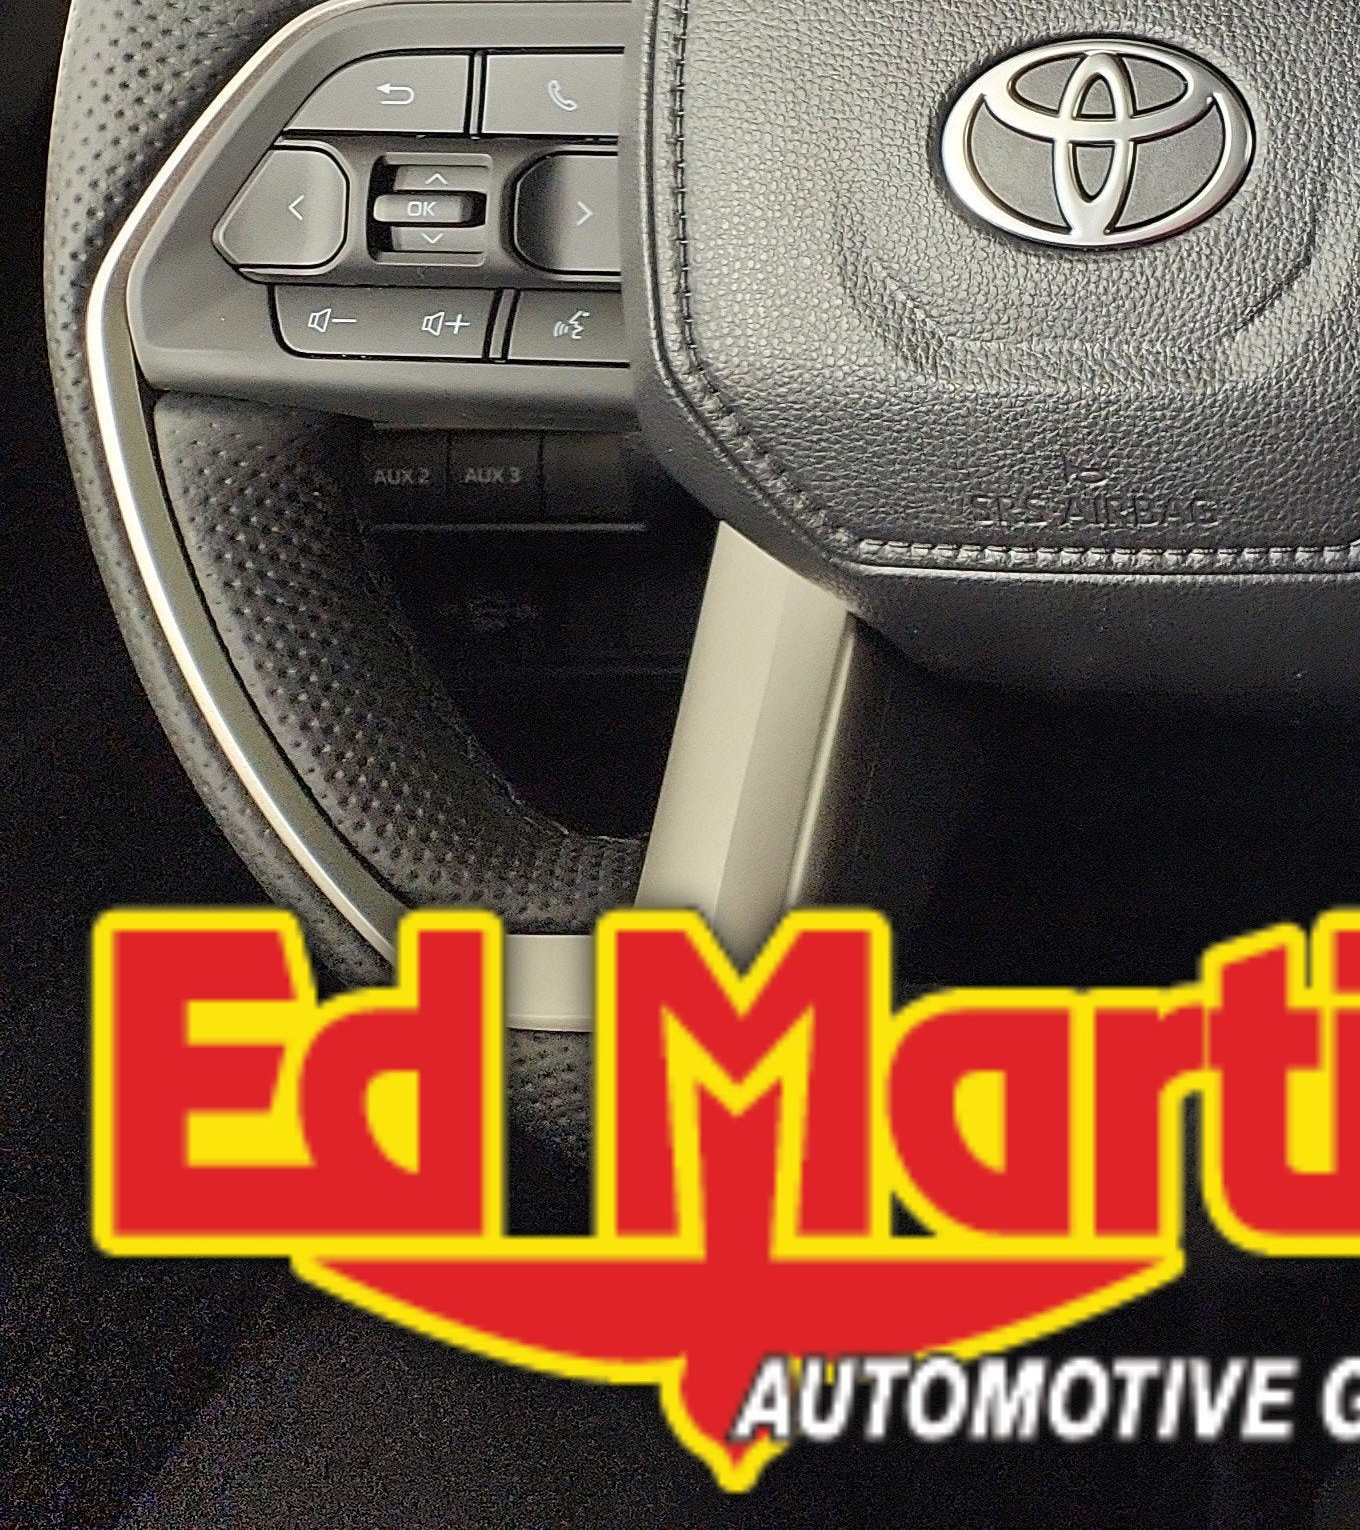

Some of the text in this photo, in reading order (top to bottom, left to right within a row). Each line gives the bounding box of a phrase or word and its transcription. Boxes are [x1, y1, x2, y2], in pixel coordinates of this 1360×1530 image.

[407, 201, 437, 218] OK
[374, 468, 413, 485] AUX
[464, 467, 523, 484] AUX 3
